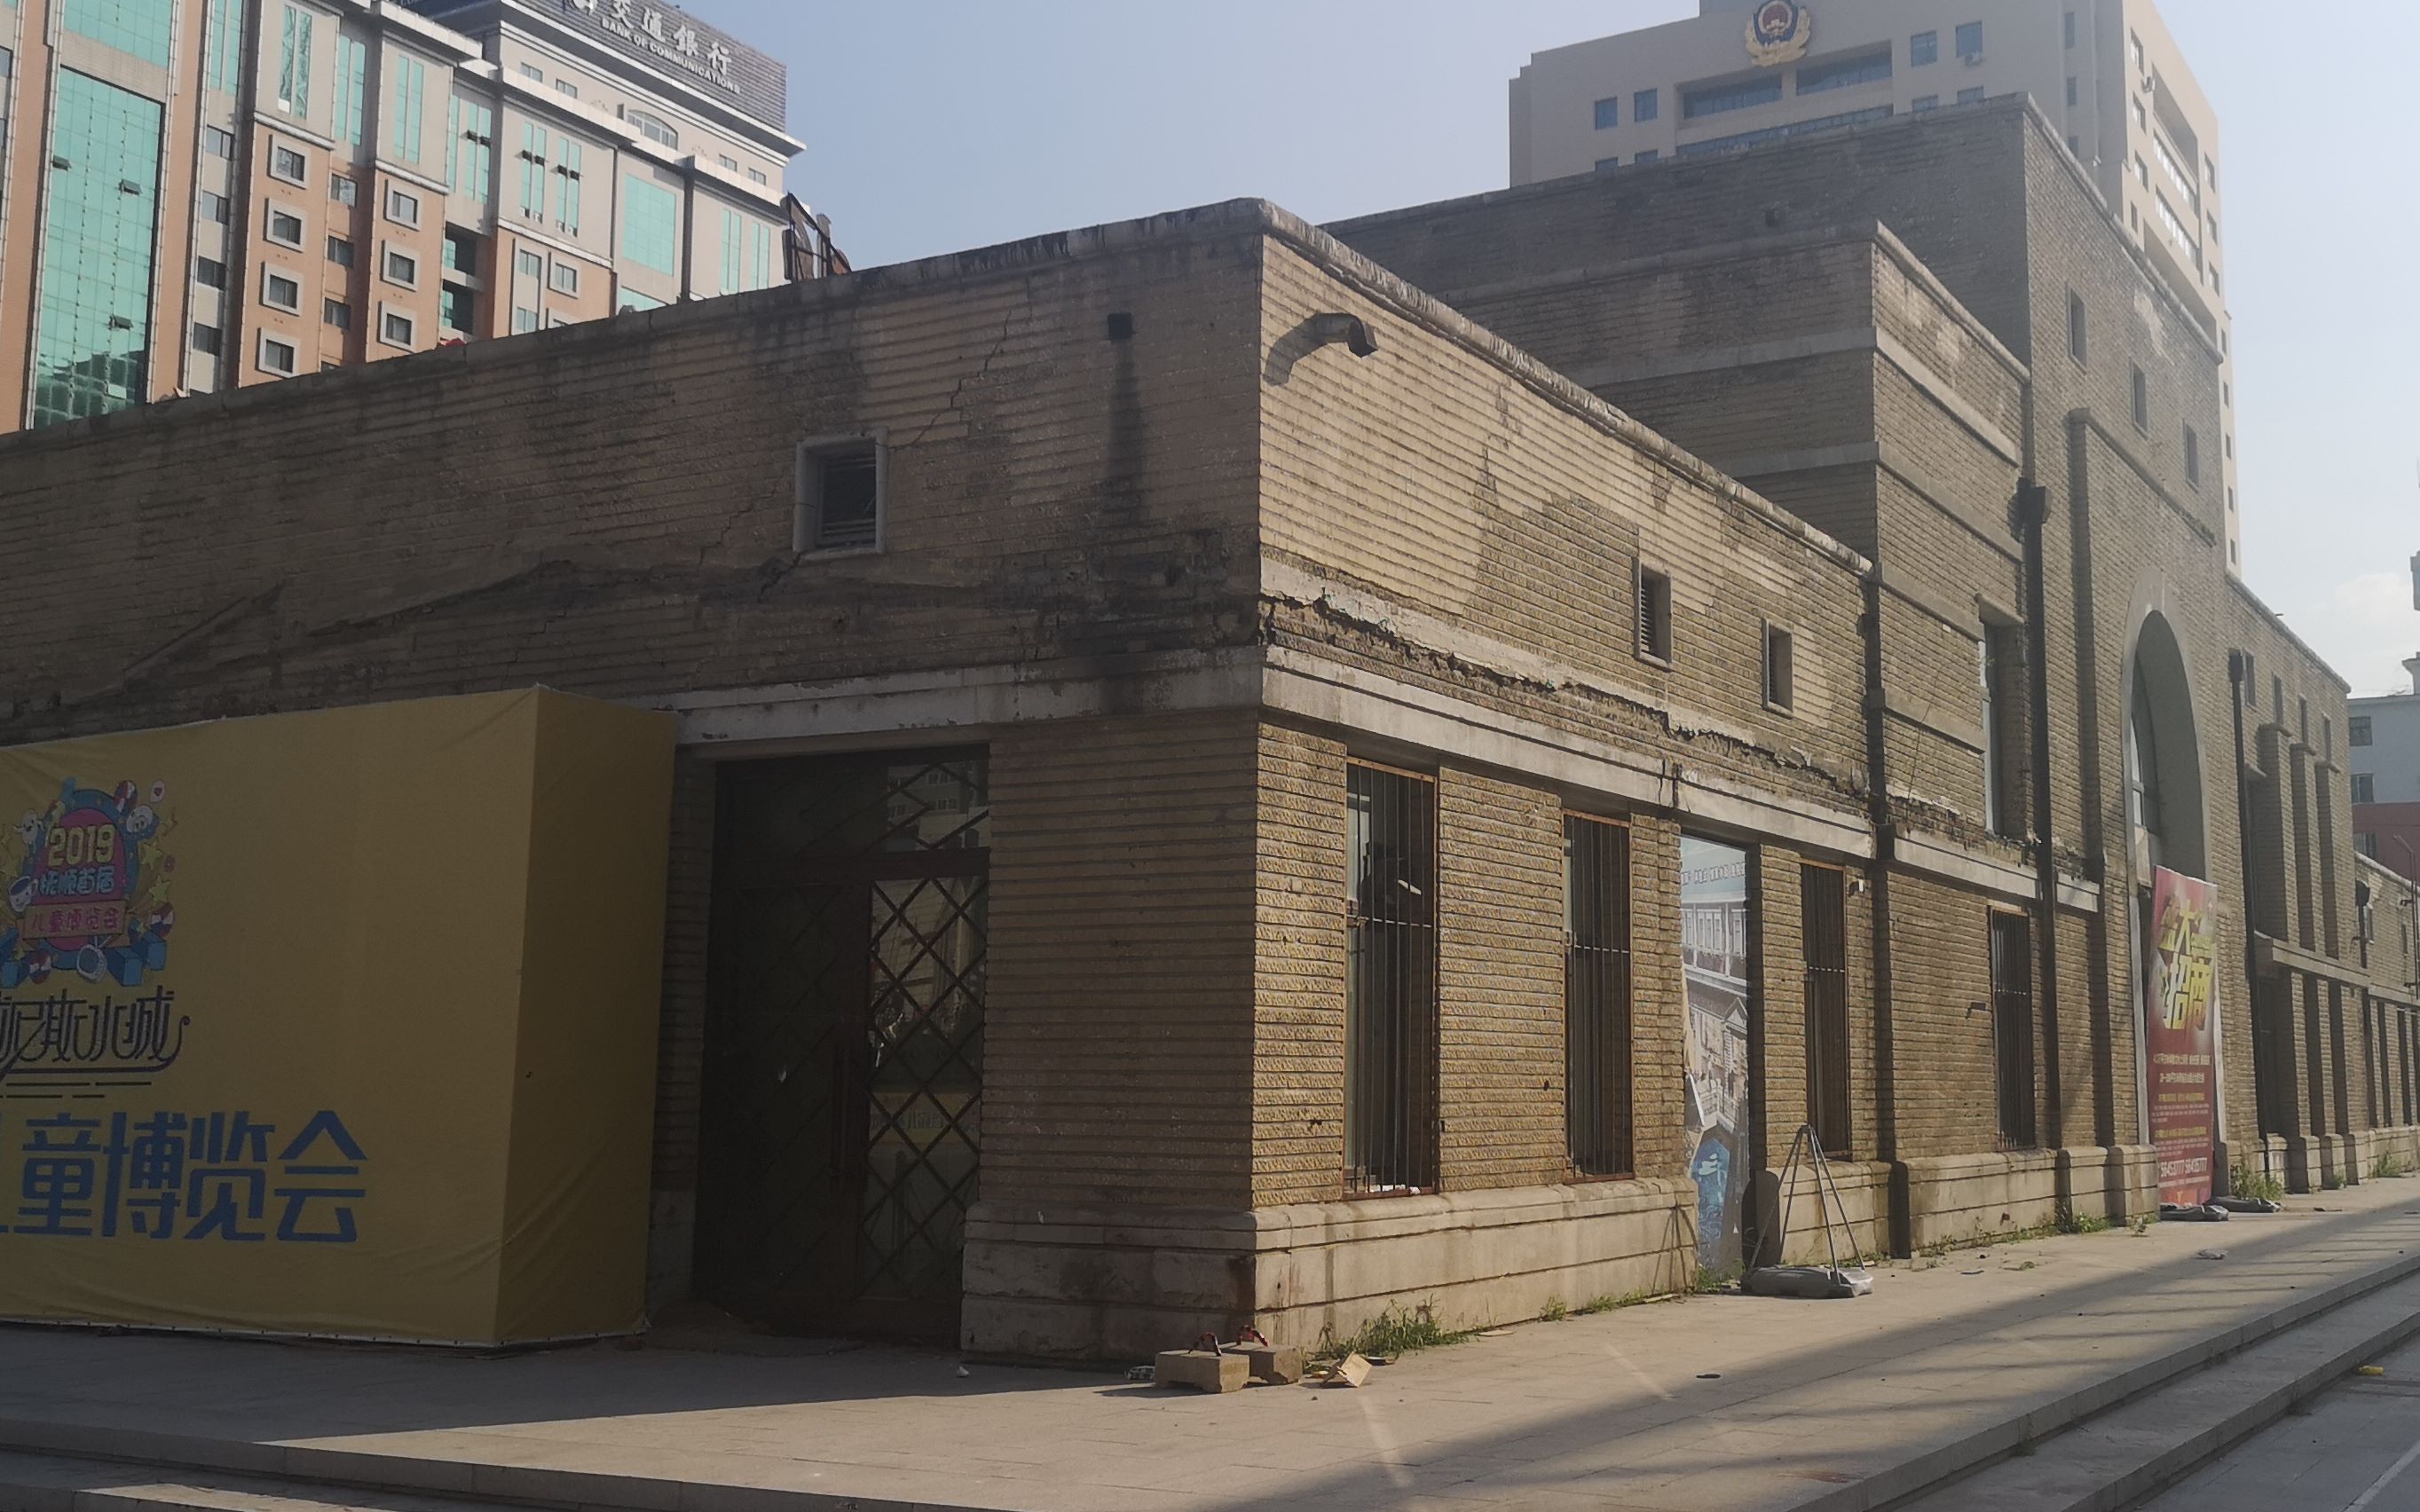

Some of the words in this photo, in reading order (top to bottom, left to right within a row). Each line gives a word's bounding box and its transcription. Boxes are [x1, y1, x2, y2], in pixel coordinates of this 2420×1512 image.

[602, 18, 633, 41] BANK
[633, 35, 650, 49] OF
[649, 41, 741, 95] COMMUNICATIONS
[47, 823, 116, 868] 2019
[30, 905, 121, 934] 儿童博览会
[0, 1108, 369, 1244] 童博览会
